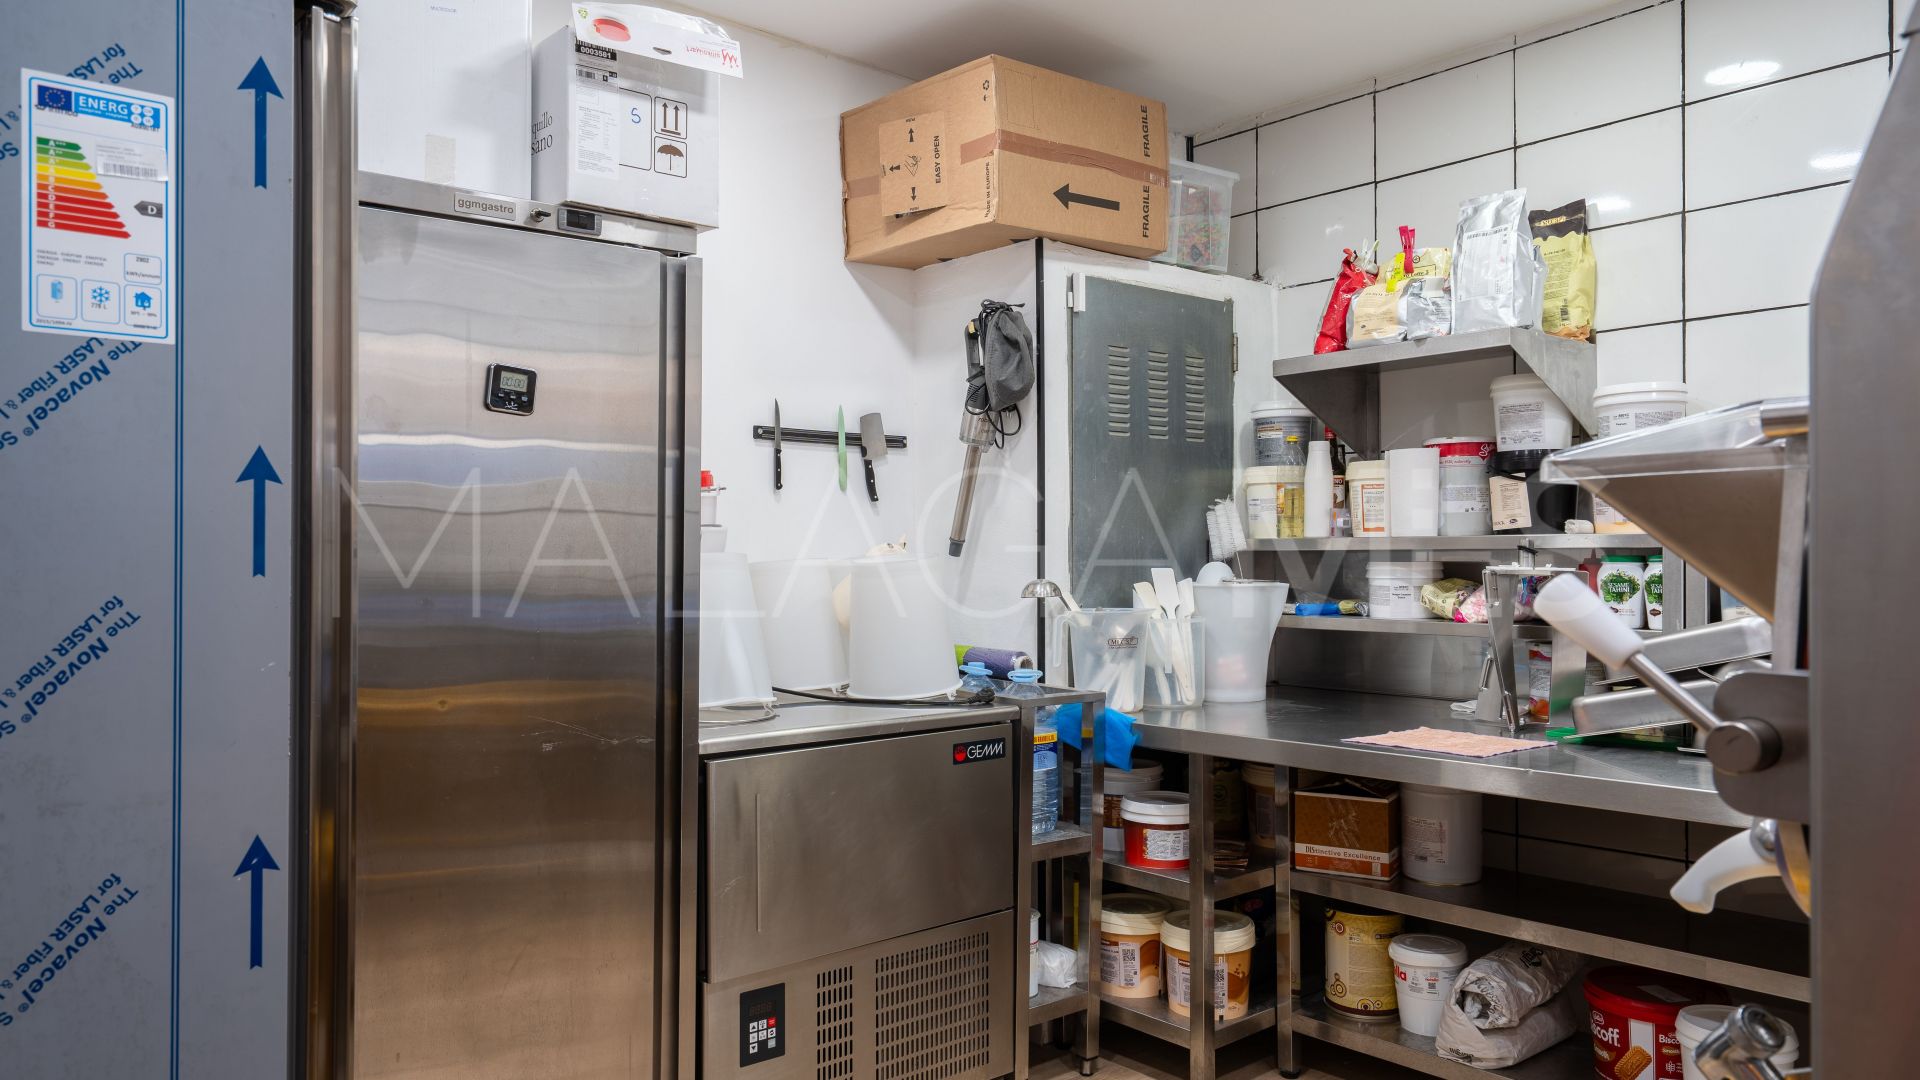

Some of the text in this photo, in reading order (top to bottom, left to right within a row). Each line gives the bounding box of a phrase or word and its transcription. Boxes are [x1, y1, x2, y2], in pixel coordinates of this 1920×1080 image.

[102, 42, 126, 62] for
[580, 46, 611, 59] 0003581
[108, 62, 143, 85] The
[79, 95, 128, 115] ENERG
[1140, 104, 1150, 158] FRAGILE
[933, 135, 941, 159] OPEN
[148, 205, 157, 215] D
[457, 199, 514, 214] ggmgastro
[1142, 185, 1150, 238] FRAGILE
[54, 337, 105, 374] LASER
[107, 340, 142, 361] The
[17, 371, 58, 404] Fiber
[99, 595, 124, 617] for
[52, 613, 103, 657] LASER
[105, 611, 141, 638] The
[15, 654, 57, 691] Fiber
[966, 741, 1003, 759] GEMM
[1343, 851, 1381, 862] Excellence
[97, 873, 122, 896] for
[103, 887, 139, 916] The
[49, 894, 101, 942] LASER
[13, 941, 54, 981] Fiber
[1591, 1022, 1620, 1047] scoff
[1658, 1033, 1680, 1045] Bisco
